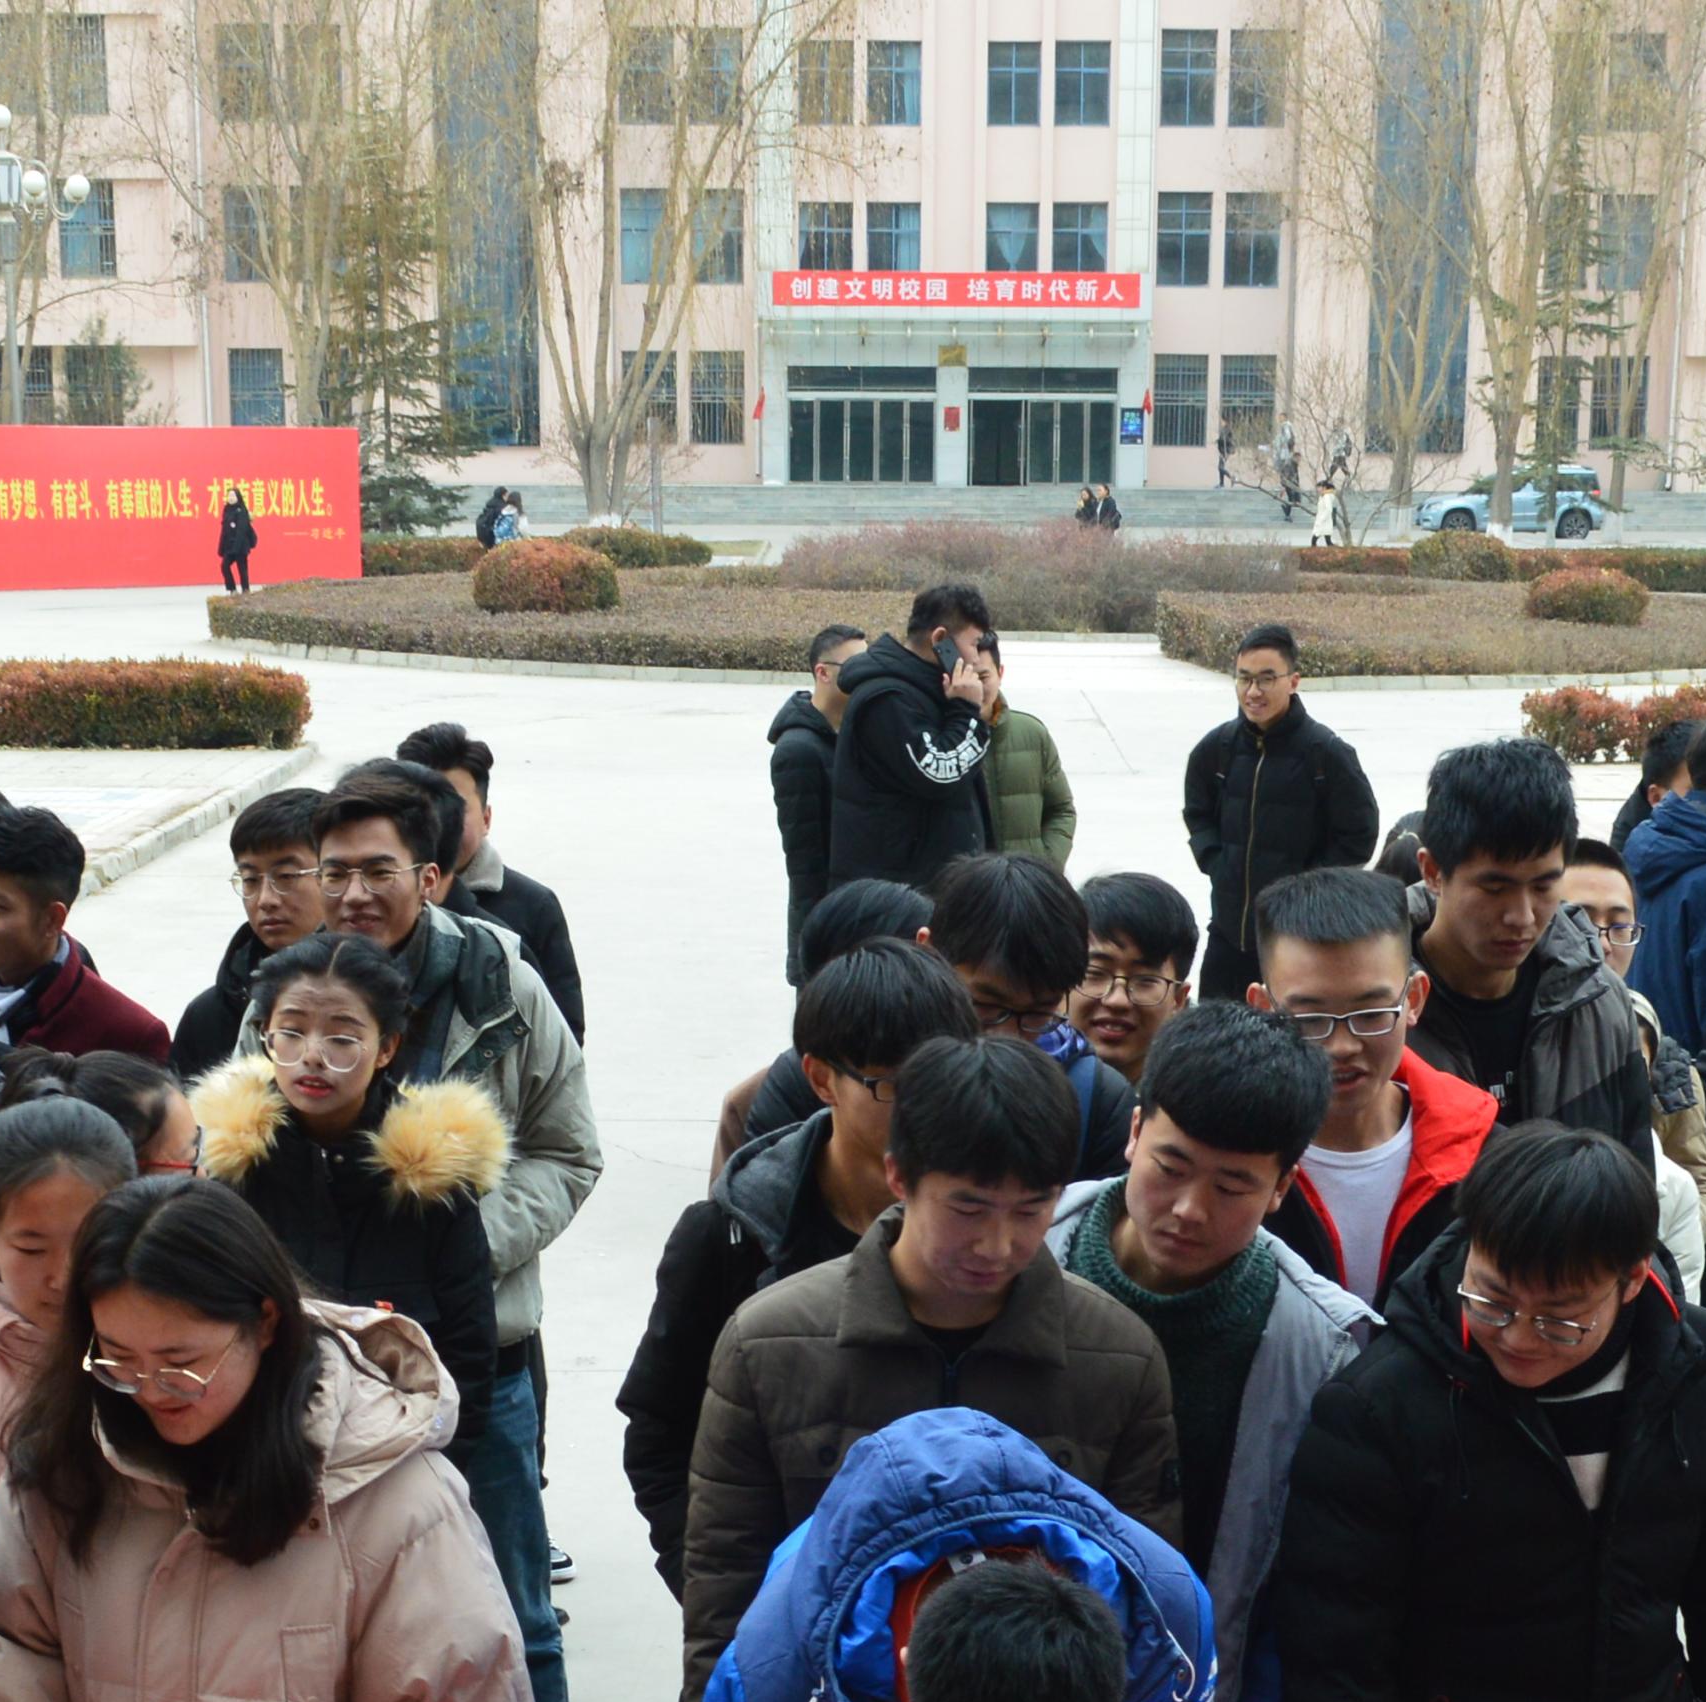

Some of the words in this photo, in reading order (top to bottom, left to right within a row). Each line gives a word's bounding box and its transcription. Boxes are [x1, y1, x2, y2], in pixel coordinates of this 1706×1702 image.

[790, 277, 948, 301] 创建文明校园
[967, 278, 1125, 302] 培育时代新人
